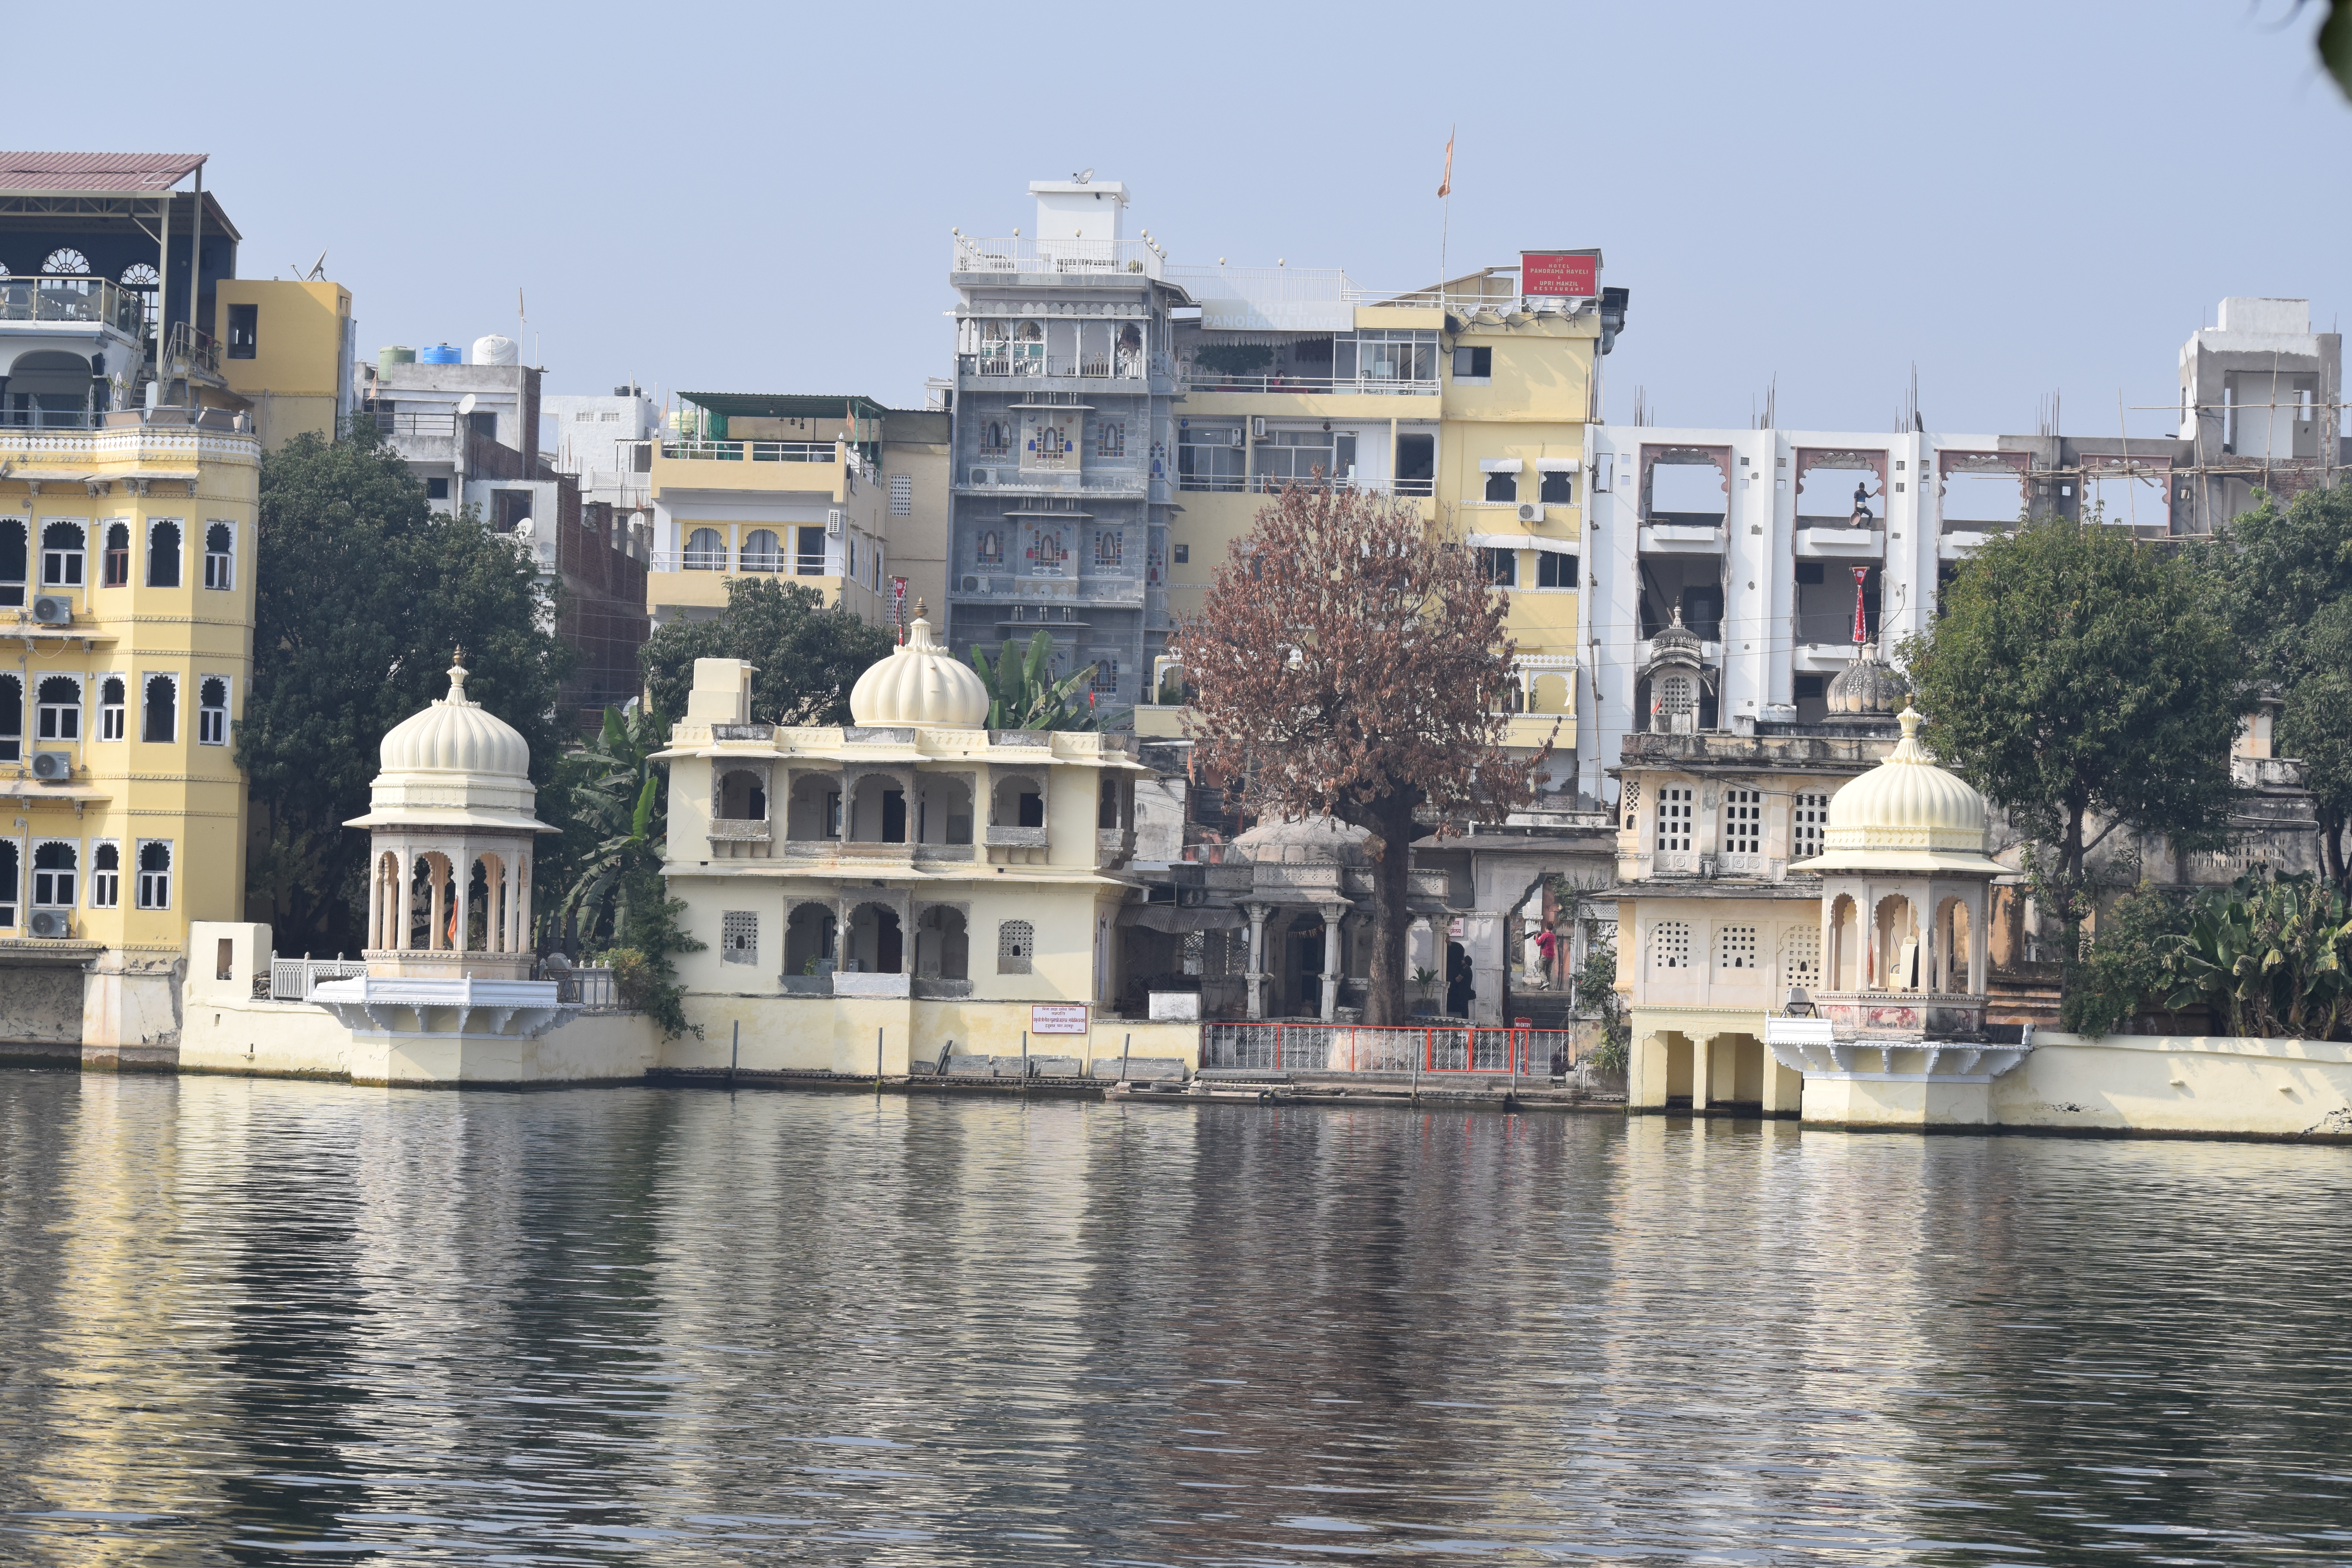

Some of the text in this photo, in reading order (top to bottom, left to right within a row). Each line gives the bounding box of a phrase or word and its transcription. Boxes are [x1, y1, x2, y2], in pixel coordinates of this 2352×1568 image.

[1248, 303, 1308, 316] HOTEL
[1203, 315, 1352, 328] PANORAMA HAVELI
